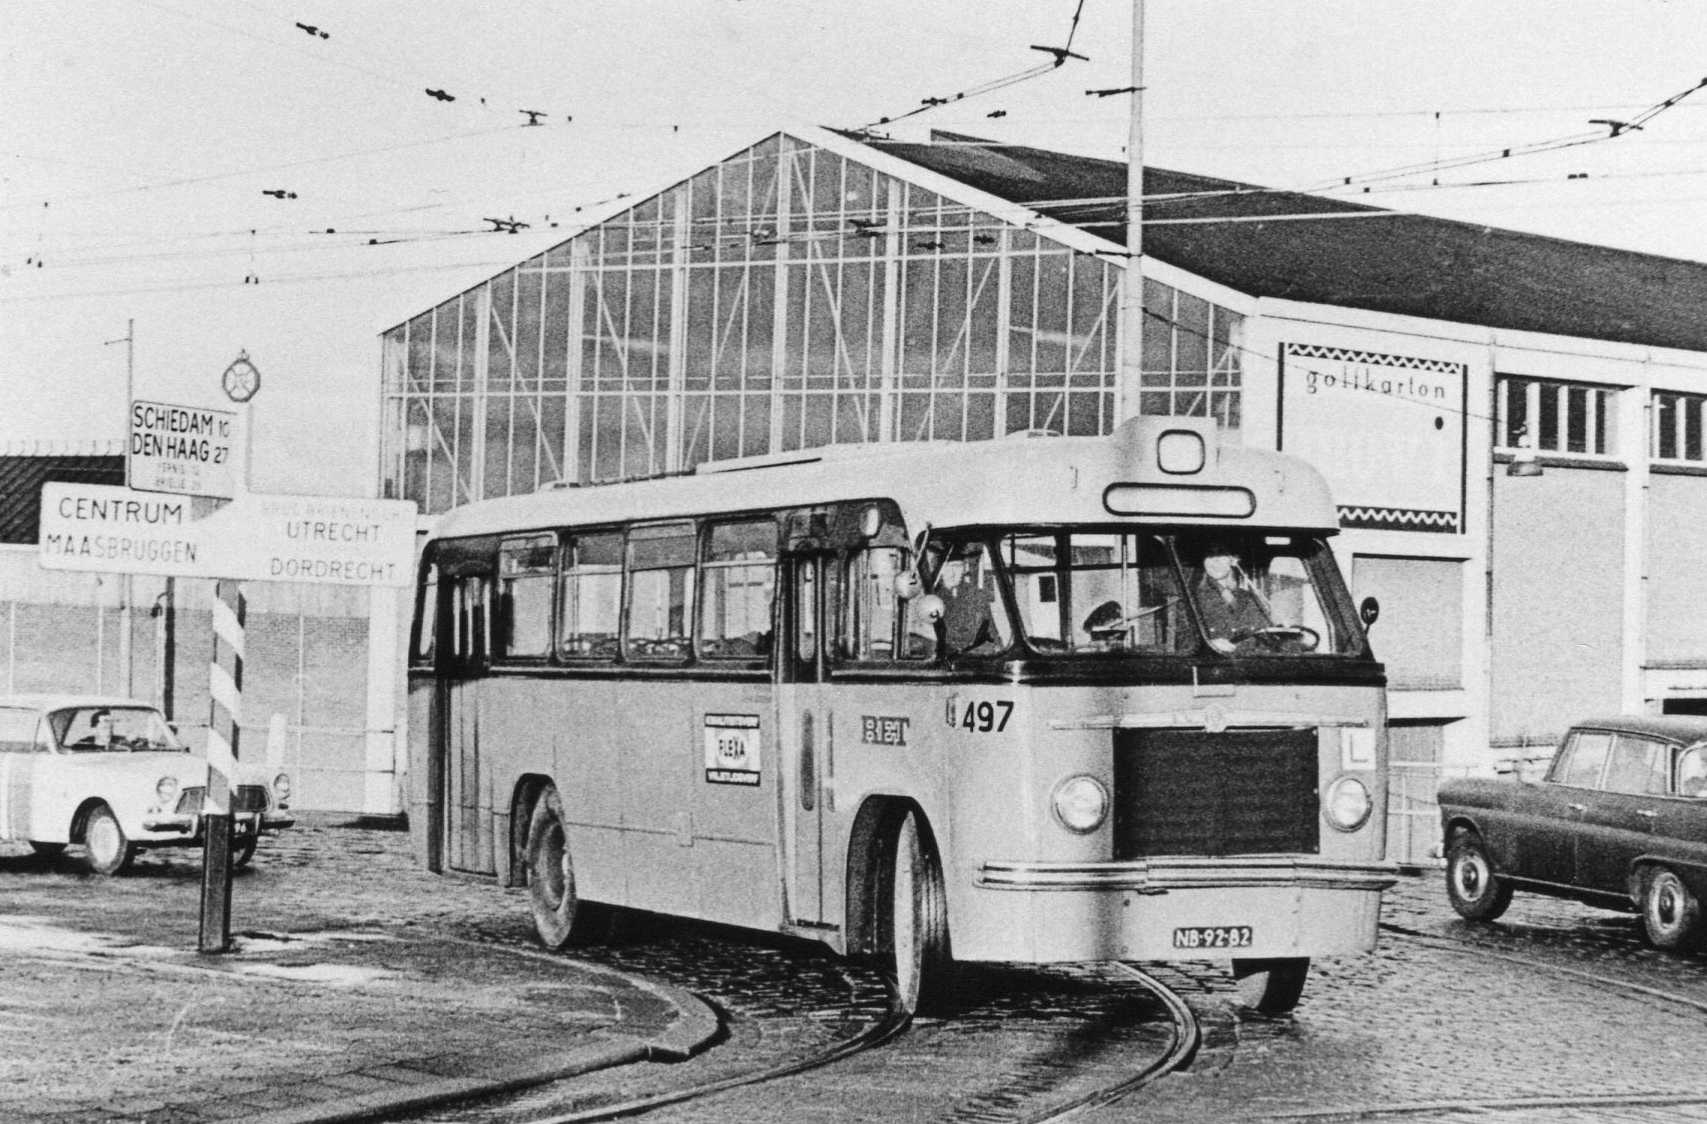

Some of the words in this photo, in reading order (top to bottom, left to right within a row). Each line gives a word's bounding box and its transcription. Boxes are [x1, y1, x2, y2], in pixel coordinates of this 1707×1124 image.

[133, 405, 213, 436] SCHIEDAM
[132, 432, 162, 456] DEN
[167, 436, 209, 462] HAAG
[213, 446, 229, 464] 27
[59, 497, 182, 524] CENTRUM
[287, 521, 380, 542] UTRECHT
[46, 534, 197, 563] MAASBRUGGEN
[271, 557, 395, 580] DORDRECHT
[861, 715, 910, 746] RET
[962, 700, 1014, 733] 497
[1350, 733, 1369, 763] L
[1174, 927, 1252, 948] NB-92-82
